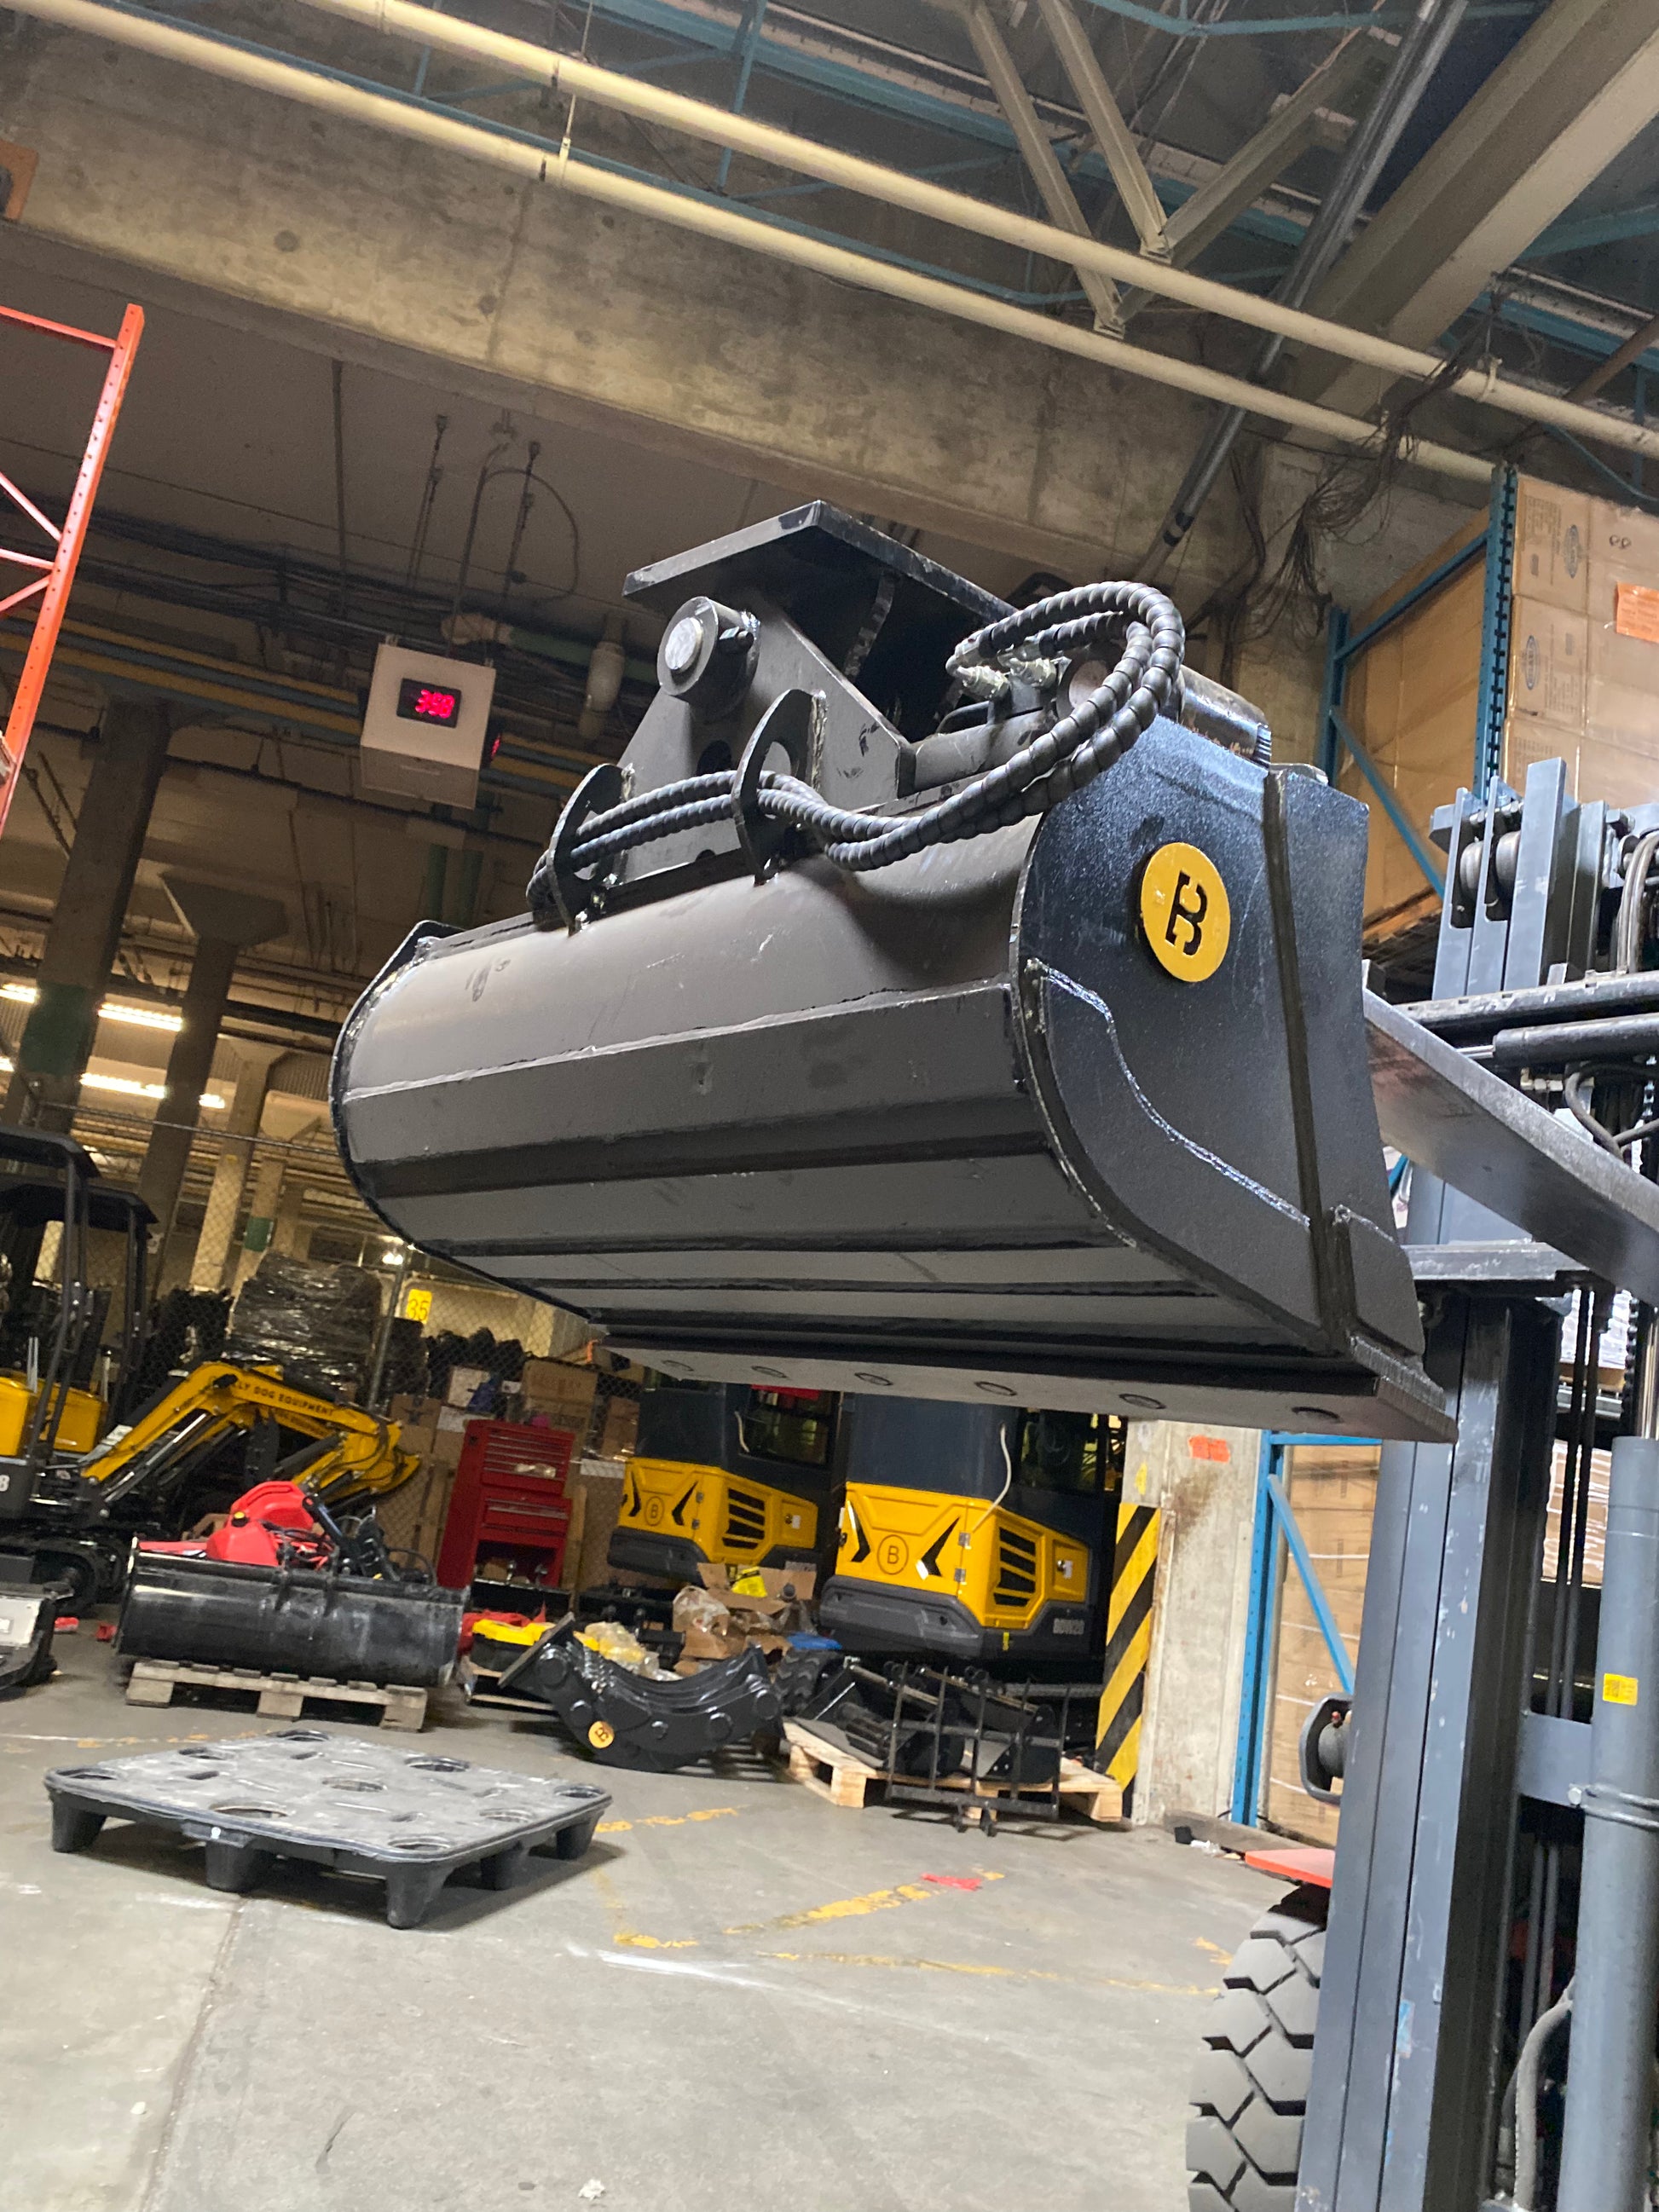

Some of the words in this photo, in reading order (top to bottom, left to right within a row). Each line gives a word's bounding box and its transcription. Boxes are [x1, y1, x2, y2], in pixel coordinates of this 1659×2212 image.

[1165, 869, 1209, 956] B
[408, 1298, 429, 1321] 35
[253, 1386, 275, 1399] DOG
[278, 1393, 333, 1417] EQUIPMENT
